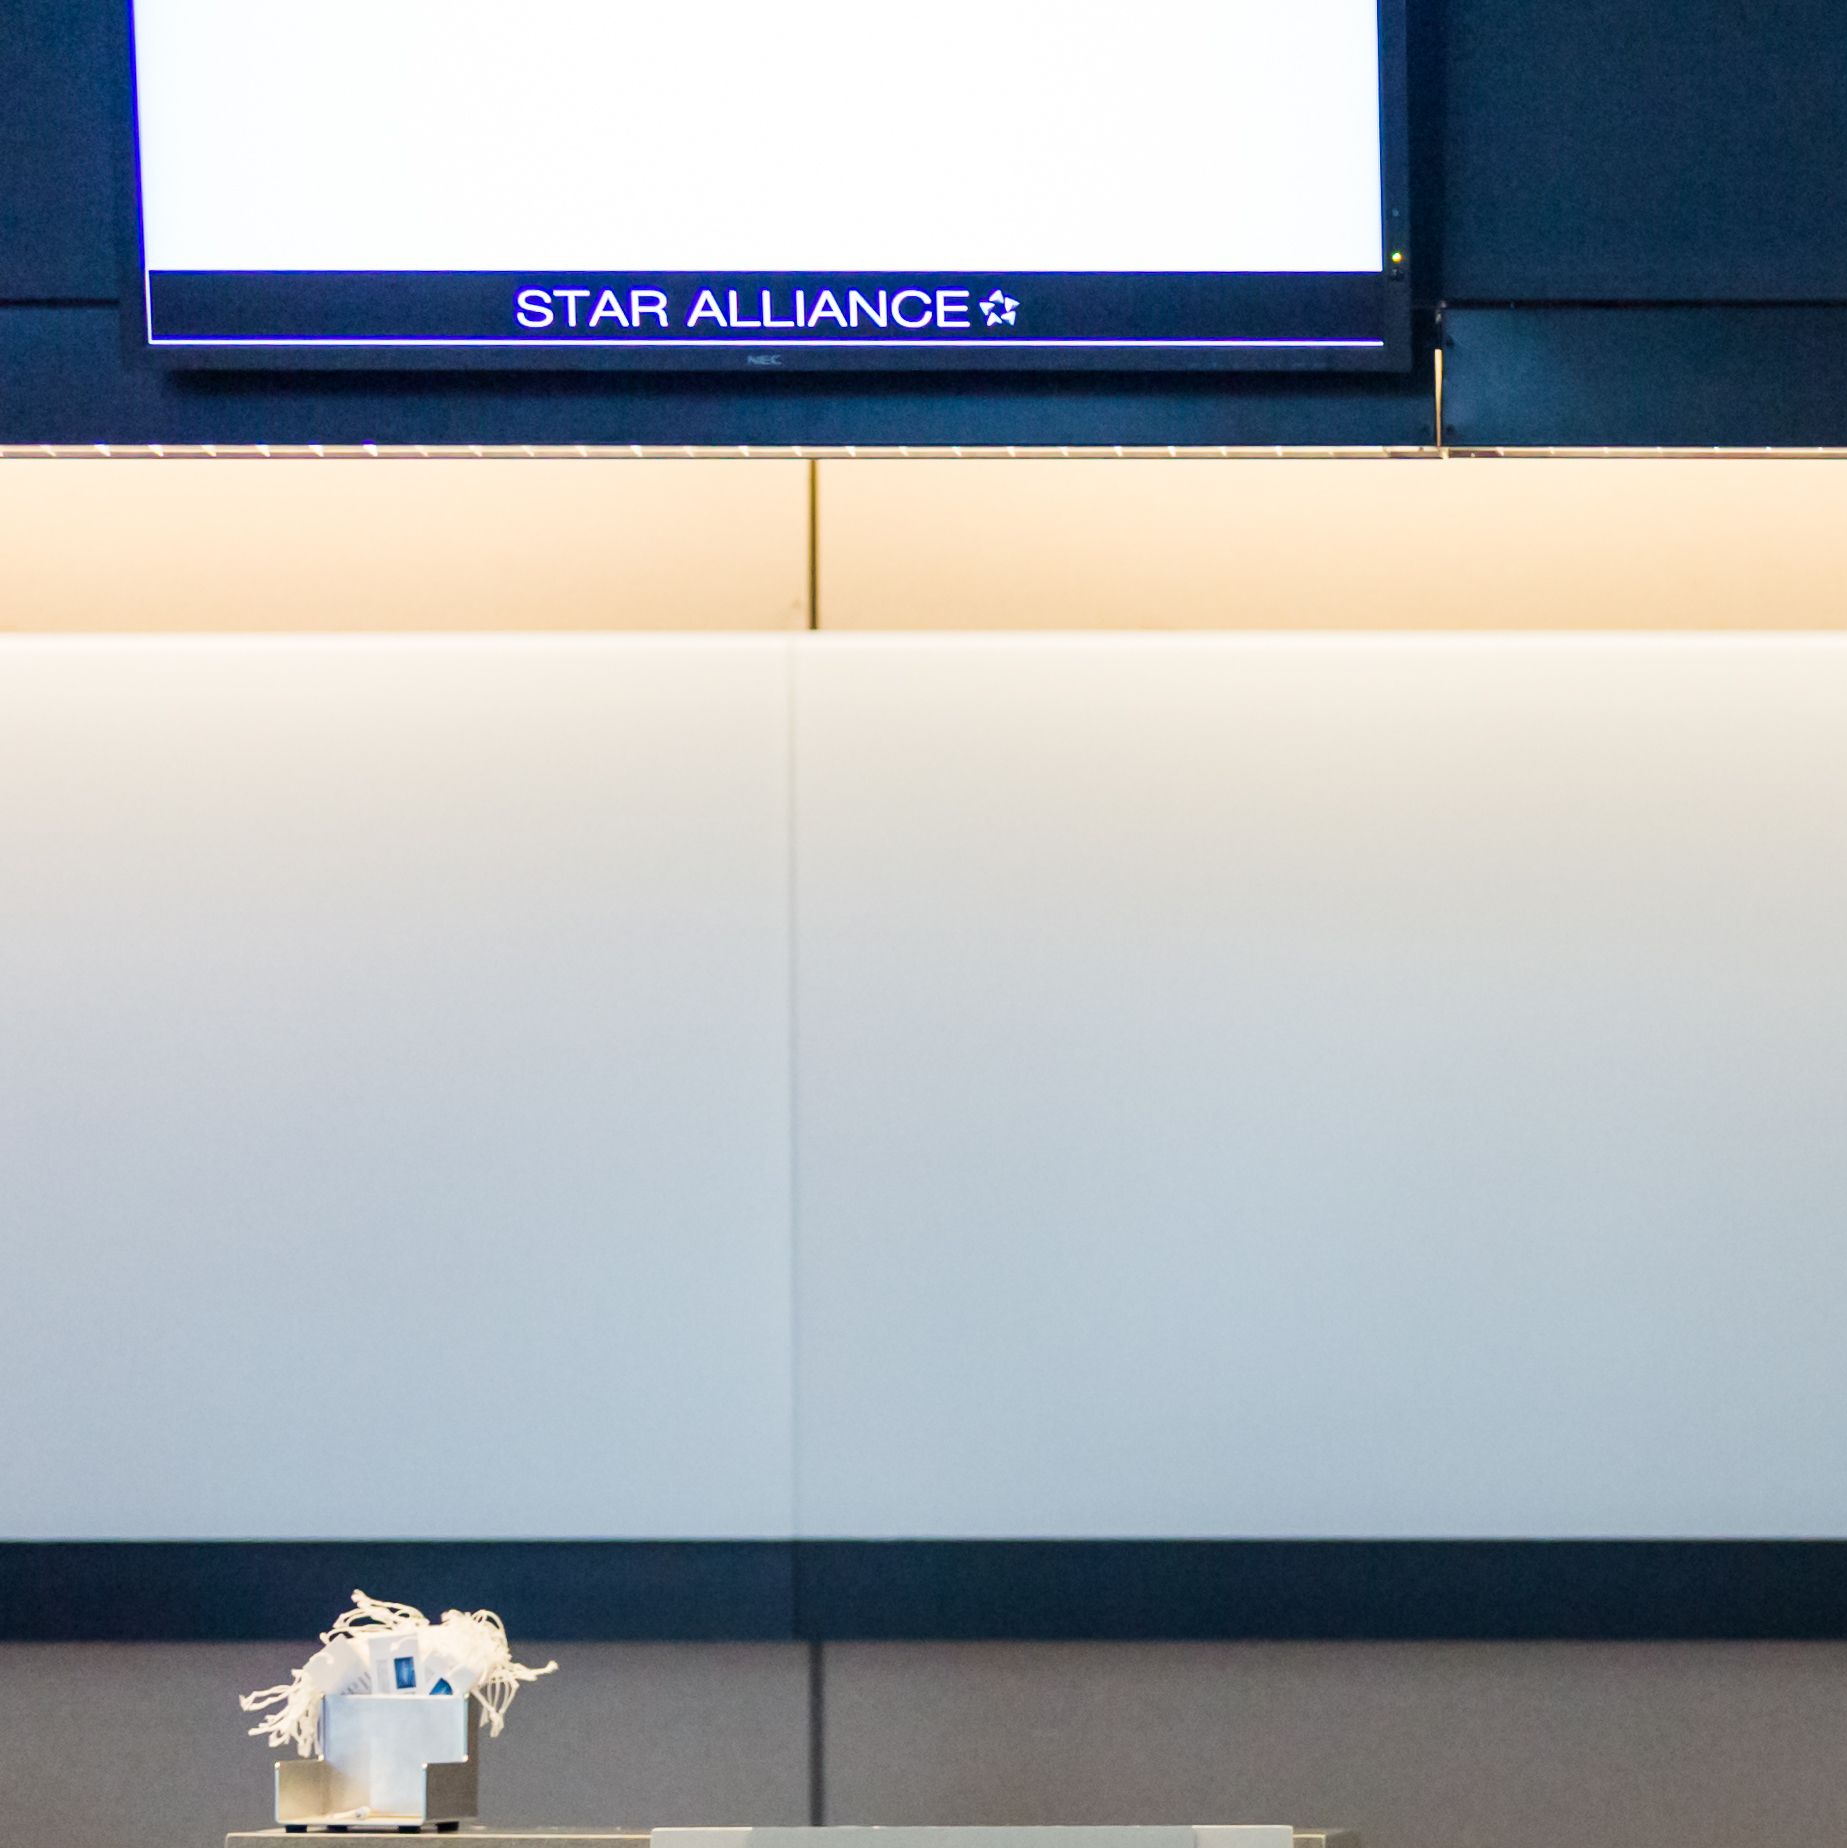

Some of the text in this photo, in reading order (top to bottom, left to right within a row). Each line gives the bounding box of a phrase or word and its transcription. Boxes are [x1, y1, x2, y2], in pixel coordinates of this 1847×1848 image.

[515, 288, 972, 329] STAR ALLIANCE
[747, 354, 782, 366] NEC
